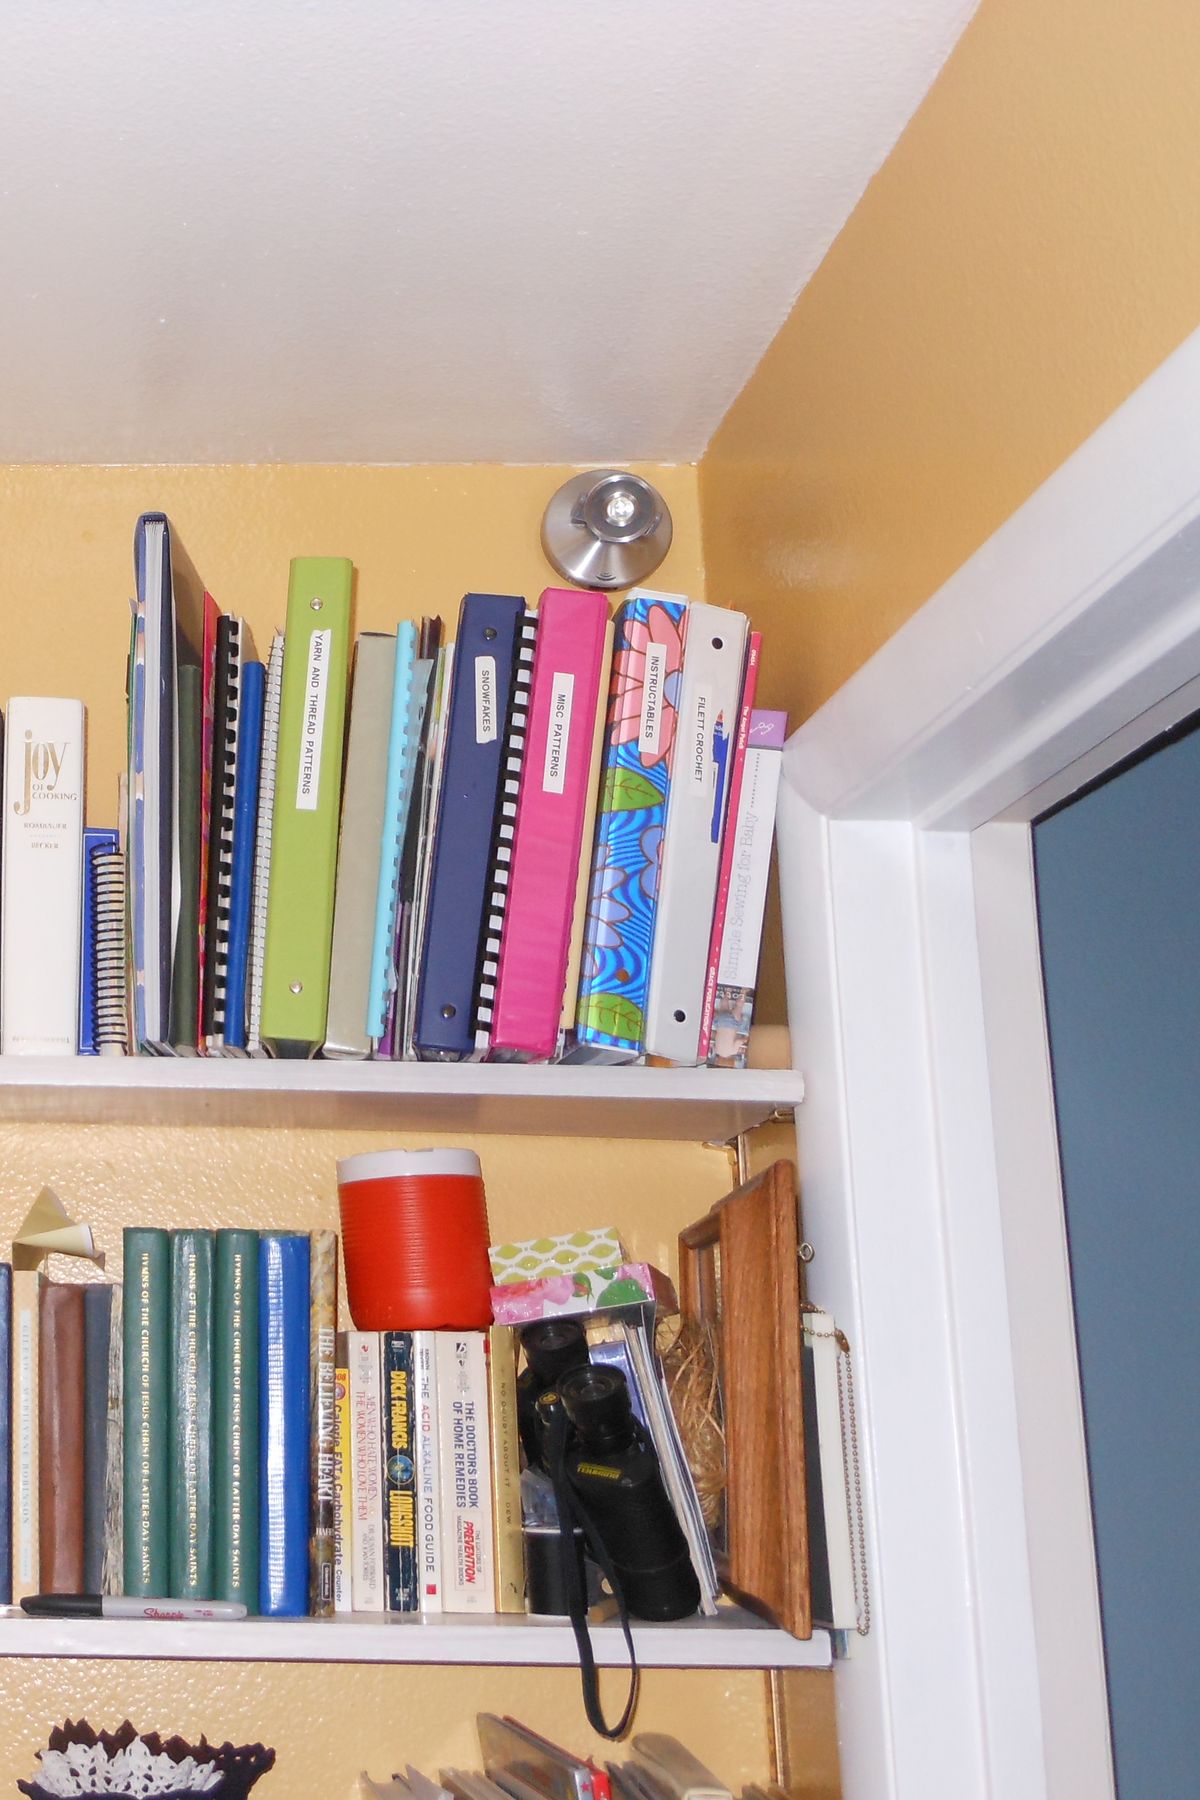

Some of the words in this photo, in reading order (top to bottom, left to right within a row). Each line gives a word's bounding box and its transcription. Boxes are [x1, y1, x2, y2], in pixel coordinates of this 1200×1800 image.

[312, 633, 324, 661] YARN
[310, 667, 321, 688] AND
[481, 670, 491, 732] SNOWFAKES
[555, 693, 567, 718] MISC
[645, 655, 660, 739] INSTRUCTABLES
[696, 696, 706, 730] FILETT
[306, 694, 319, 735] THREAD
[550, 724, 563, 777] PATTERNS
[695, 733, 704, 783] CROCHET
[13, 729, 71, 815] joy
[301, 740, 314, 795] PATTERNS
[32, 793, 78, 801] COOKING
[141, 1253, 150, 1288] HYMNS
[232, 1254, 241, 1290] HYMNS
[141, 1291, 150, 1305] OF
[232, 1292, 241, 1306] OF
[141, 1308, 150, 1326] THE
[232, 1309, 241, 1328] THE
[141, 1329, 150, 1372] CHURCH
[232, 1331, 241, 1374] CHURCH
[318, 1325, 335, 1357] THE
[141, 1375, 150, 1387] OF
[232, 1376, 241, 1390] OF
[390, 1371, 408, 1398] DICK
[421, 1376, 429, 1398] THE
[141, 1391, 150, 1419] JESUS
[232, 1393, 241, 1422] JESUS
[317, 1360, 335, 1448] BELIEVING
[356, 1391, 366, 1408] THE
[453, 1401, 462, 1413] OF
[465, 1402, 475, 1421] THE
[356, 1410, 367, 1444] WOMEN
[366, 1417, 378, 1440] WHO
[391, 1400, 409, 1449] FRANCIS
[421, 1405, 430, 1431] ACID
[453, 1418, 464, 1449] HOME
[141, 1422, 150, 1458] CHRIST
[232, 1425, 241, 1460] CHRIST
[367, 1442, 378, 1464] HATE
[465, 1425, 477, 1475] DOCTORS
[141, 1461, 150, 1476] OF
[232, 1464, 241, 1478] OF
[356, 1446, 367, 1470] WHO
[422, 1435, 432, 1493] ALKALINE
[317, 1452, 335, 1505] HEART
[357, 1471, 368, 1494] LOVE
[367, 1465, 378, 1501] WOMEN
[455, 1453, 466, 1508] REMEDIES
[468, 1479, 478, 1509] BOOK
[141, 1478, 150, 1541] LATTER-DAY
[232, 1481, 241, 1545] LATTER-DAY
[333, 1484, 344, 1565] Carbohydrate
[357, 1495, 369, 1521] THEM
[389, 1490, 415, 1549] LONGSHOT
[424, 1498, 433, 1530] FOOD
[141, 1546, 150, 1583] SAINTS
[232, 1549, 241, 1588] SAINTS
[425, 1534, 435, 1572] GUIDE
[463, 1521, 477, 1584] PREVENTION
[335, 1569, 343, 1602] Counter
